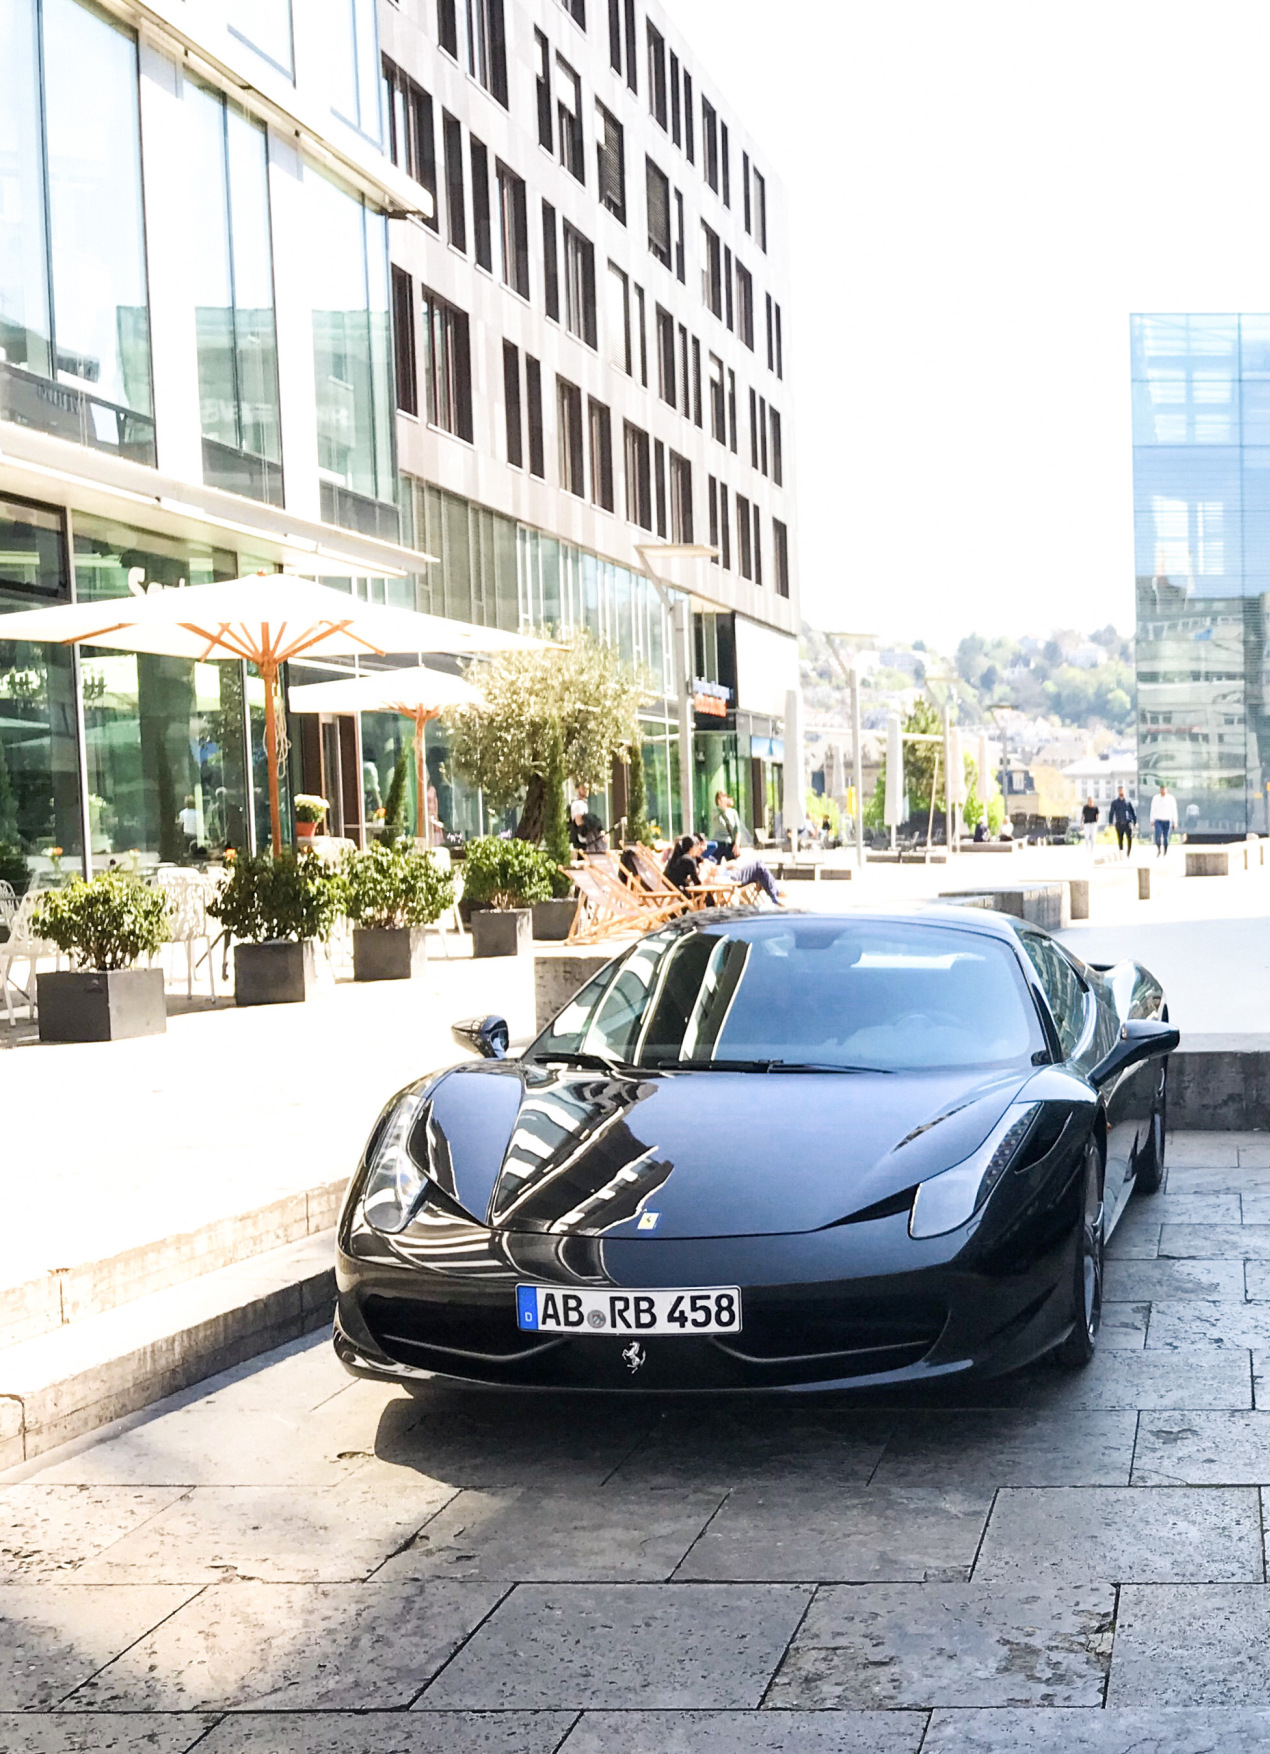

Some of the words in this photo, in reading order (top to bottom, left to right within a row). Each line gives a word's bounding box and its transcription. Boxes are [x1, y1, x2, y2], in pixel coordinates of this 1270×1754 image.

[541, 1293, 585, 1327] AB
[609, 1296, 657, 1329] RB
[667, 1294, 736, 1328] 458
